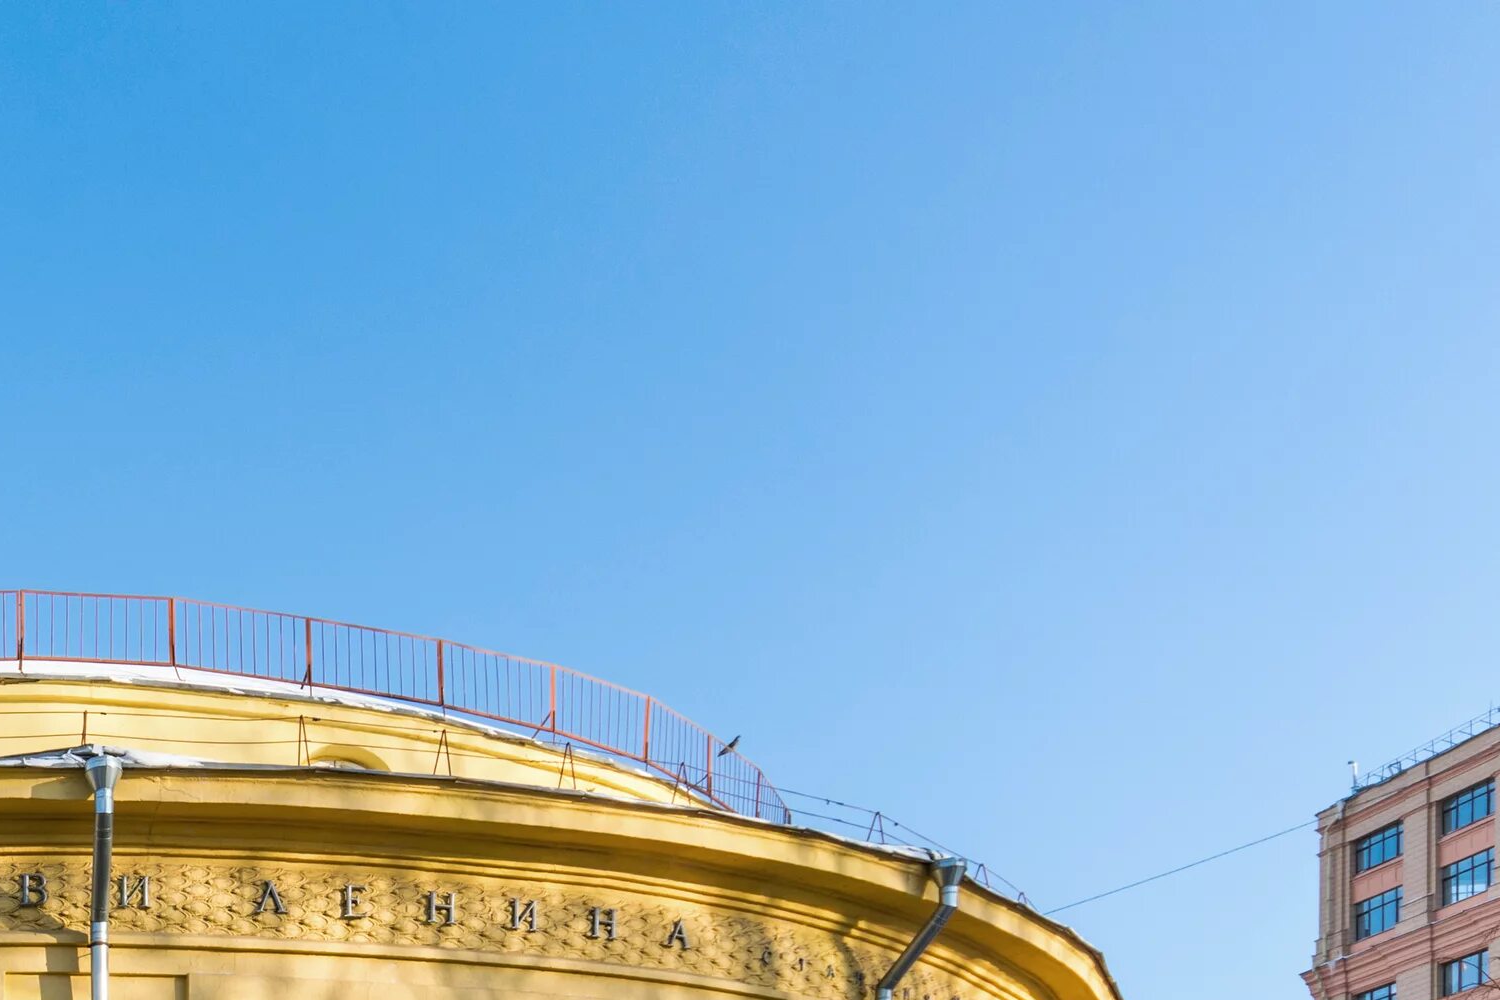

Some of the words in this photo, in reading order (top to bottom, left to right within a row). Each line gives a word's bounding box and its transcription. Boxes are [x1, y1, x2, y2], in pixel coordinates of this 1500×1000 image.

[20, 873, 49, 908] В
[118, 875, 151, 909] И
[255, 879, 691, 950] ЛЕНИНА
